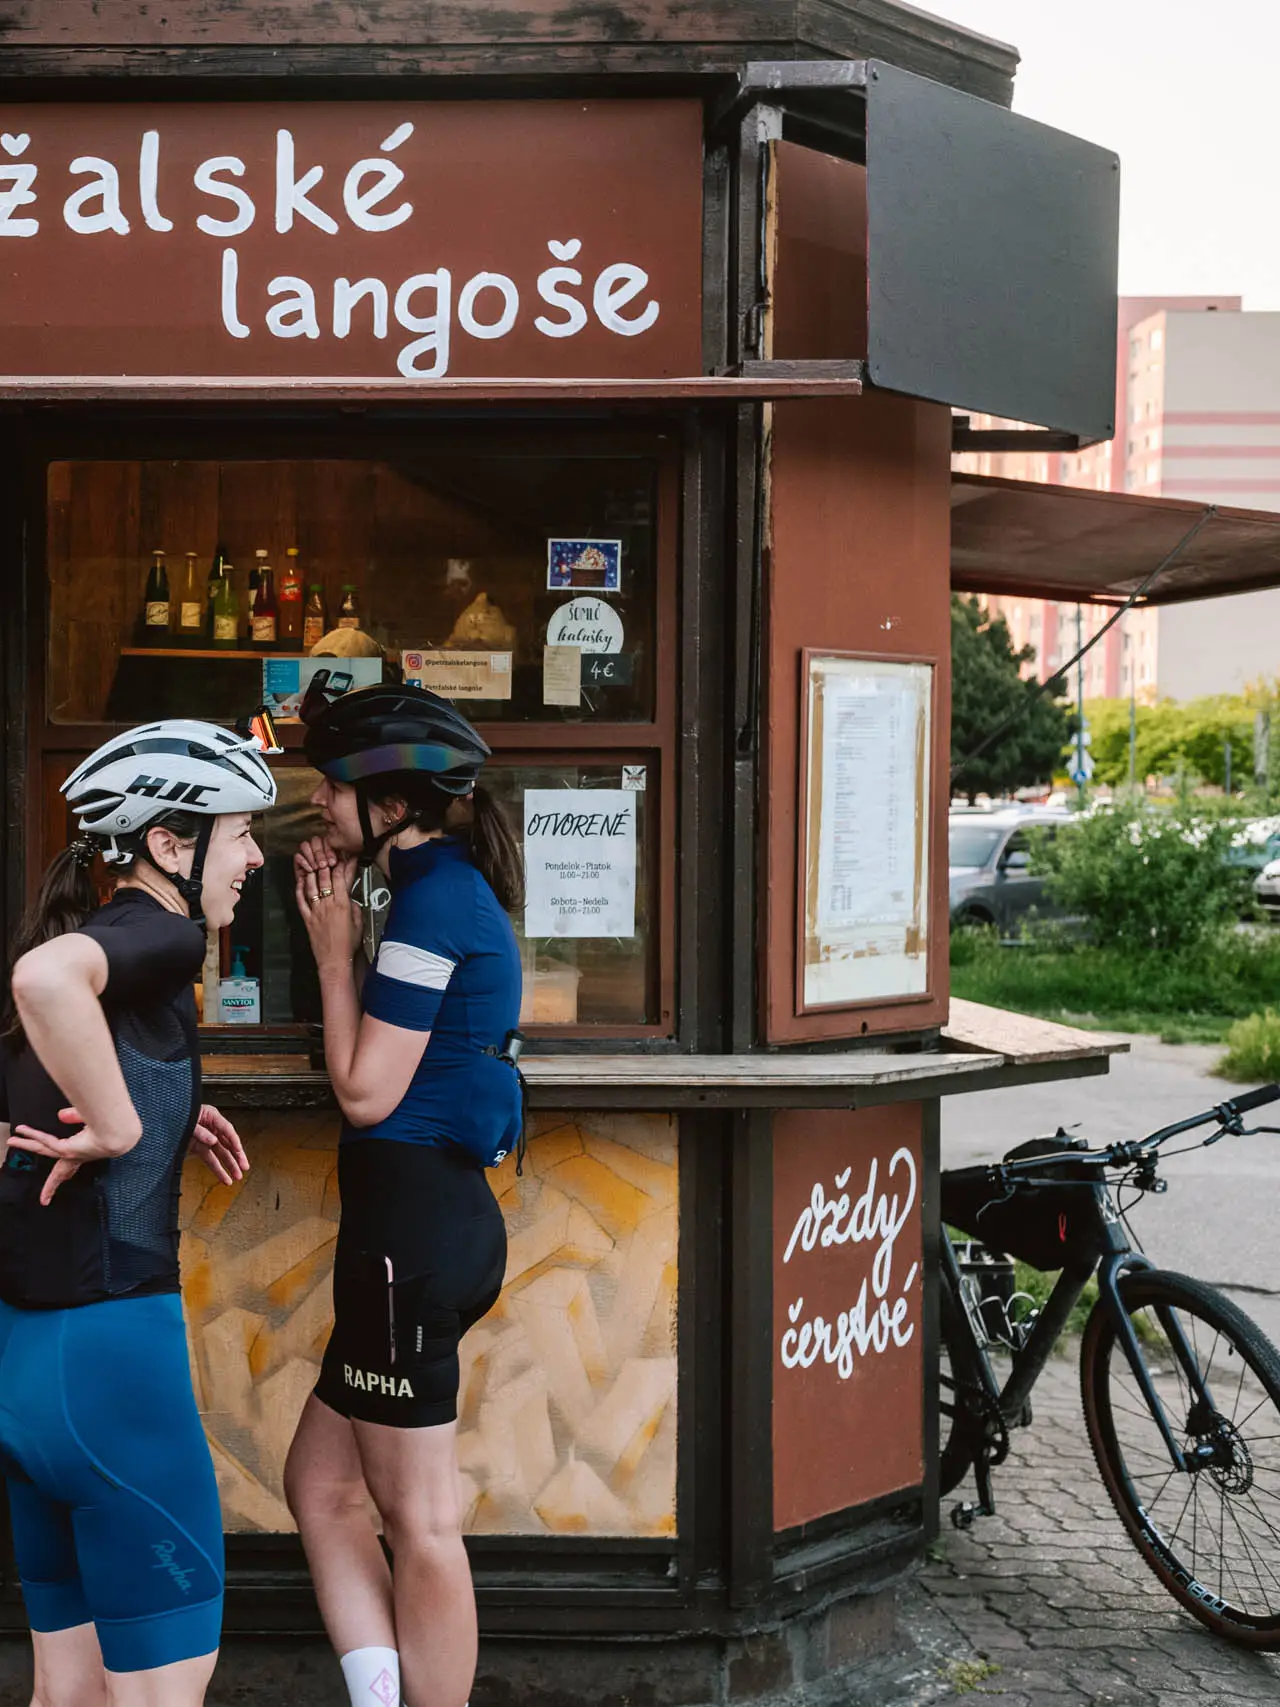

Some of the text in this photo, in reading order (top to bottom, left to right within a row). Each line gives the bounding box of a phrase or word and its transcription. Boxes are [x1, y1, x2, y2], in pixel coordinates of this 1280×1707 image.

[220, 238, 661, 378] langoše
[590, 660, 615, 680] 4€
[124, 774, 221, 808] HJC
[527, 808, 632, 838] OTVORENÉ
[782, 1146, 918, 1298] vždy
[343, 1363, 415, 1398] RAPHA
